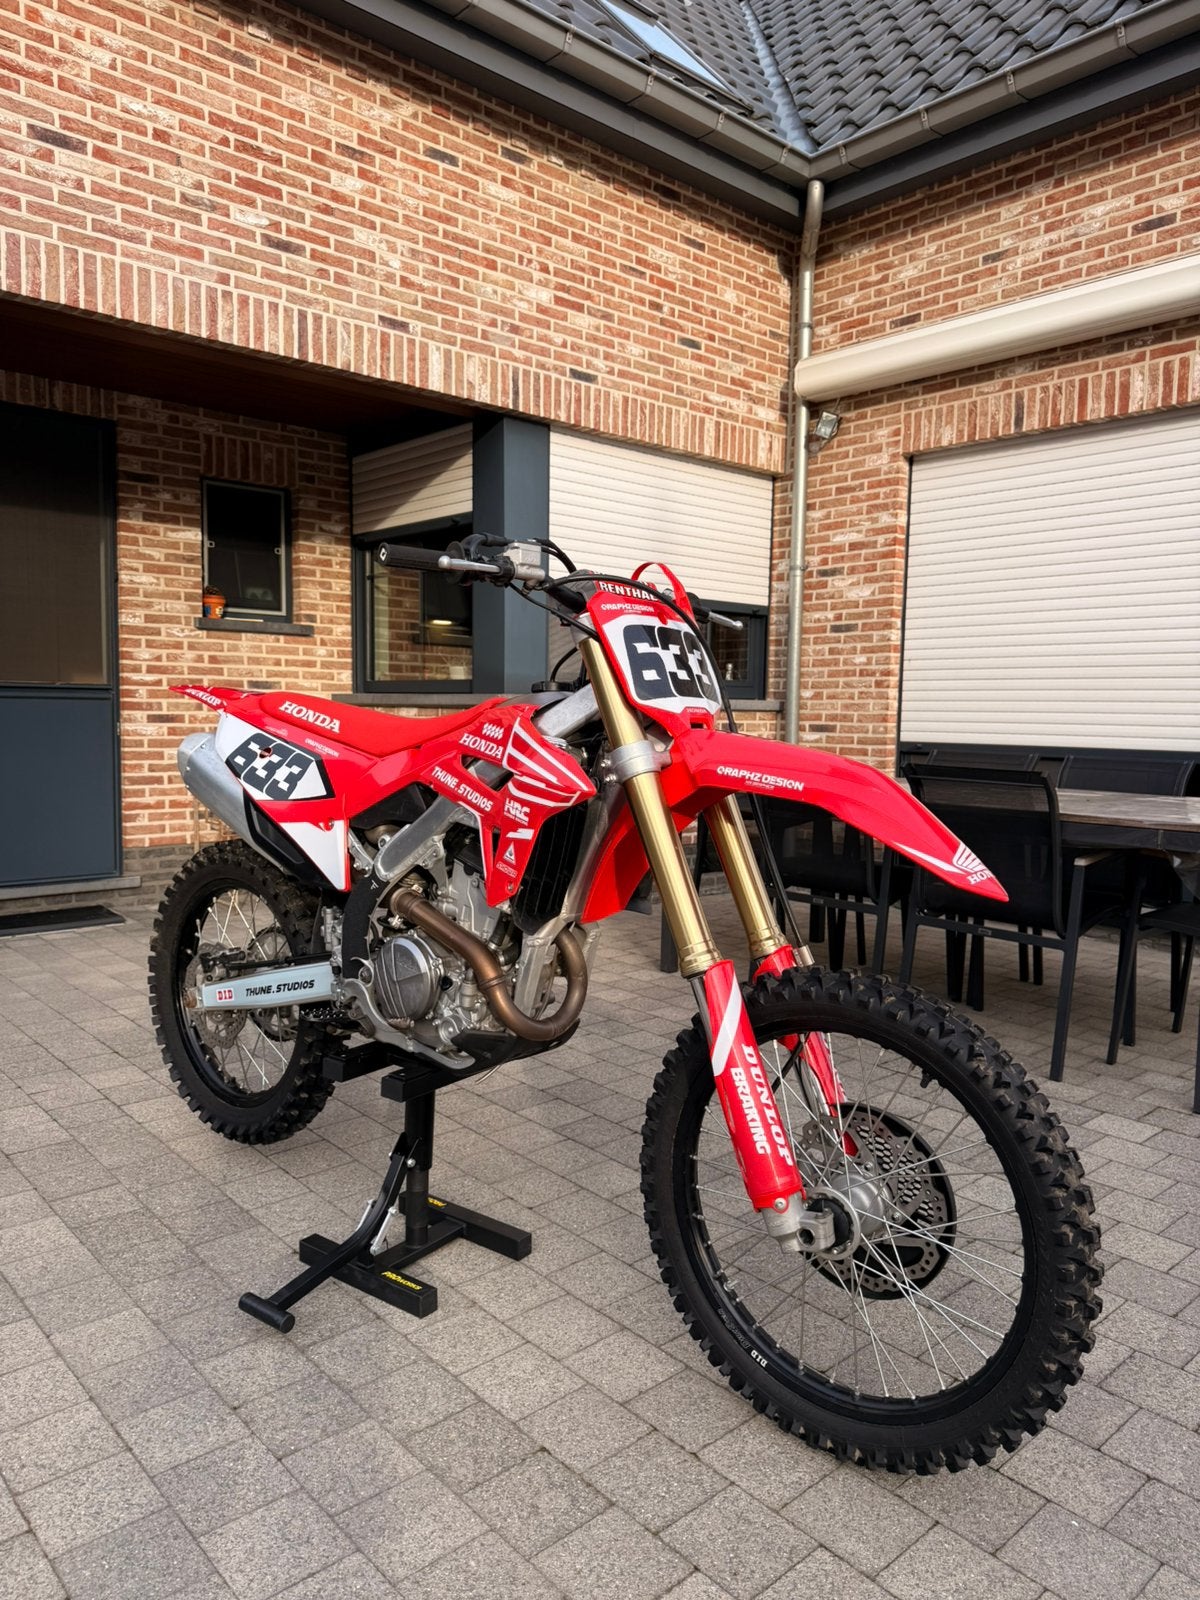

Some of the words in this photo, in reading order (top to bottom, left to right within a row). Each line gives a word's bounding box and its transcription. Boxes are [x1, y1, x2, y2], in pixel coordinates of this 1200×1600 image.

[623, 624, 721, 704] 633
[279, 701, 341, 733] HONDA
[458, 733, 504, 759] HONDA
[226, 732, 314, 800] 633
[762, 774, 804, 791] DESIGN
[504, 797, 530, 823] HRC
[217, 989, 233, 1001] DID
[730, 1067, 772, 1155] BRAKING
[741, 1043, 794, 1167] DUNLOP
